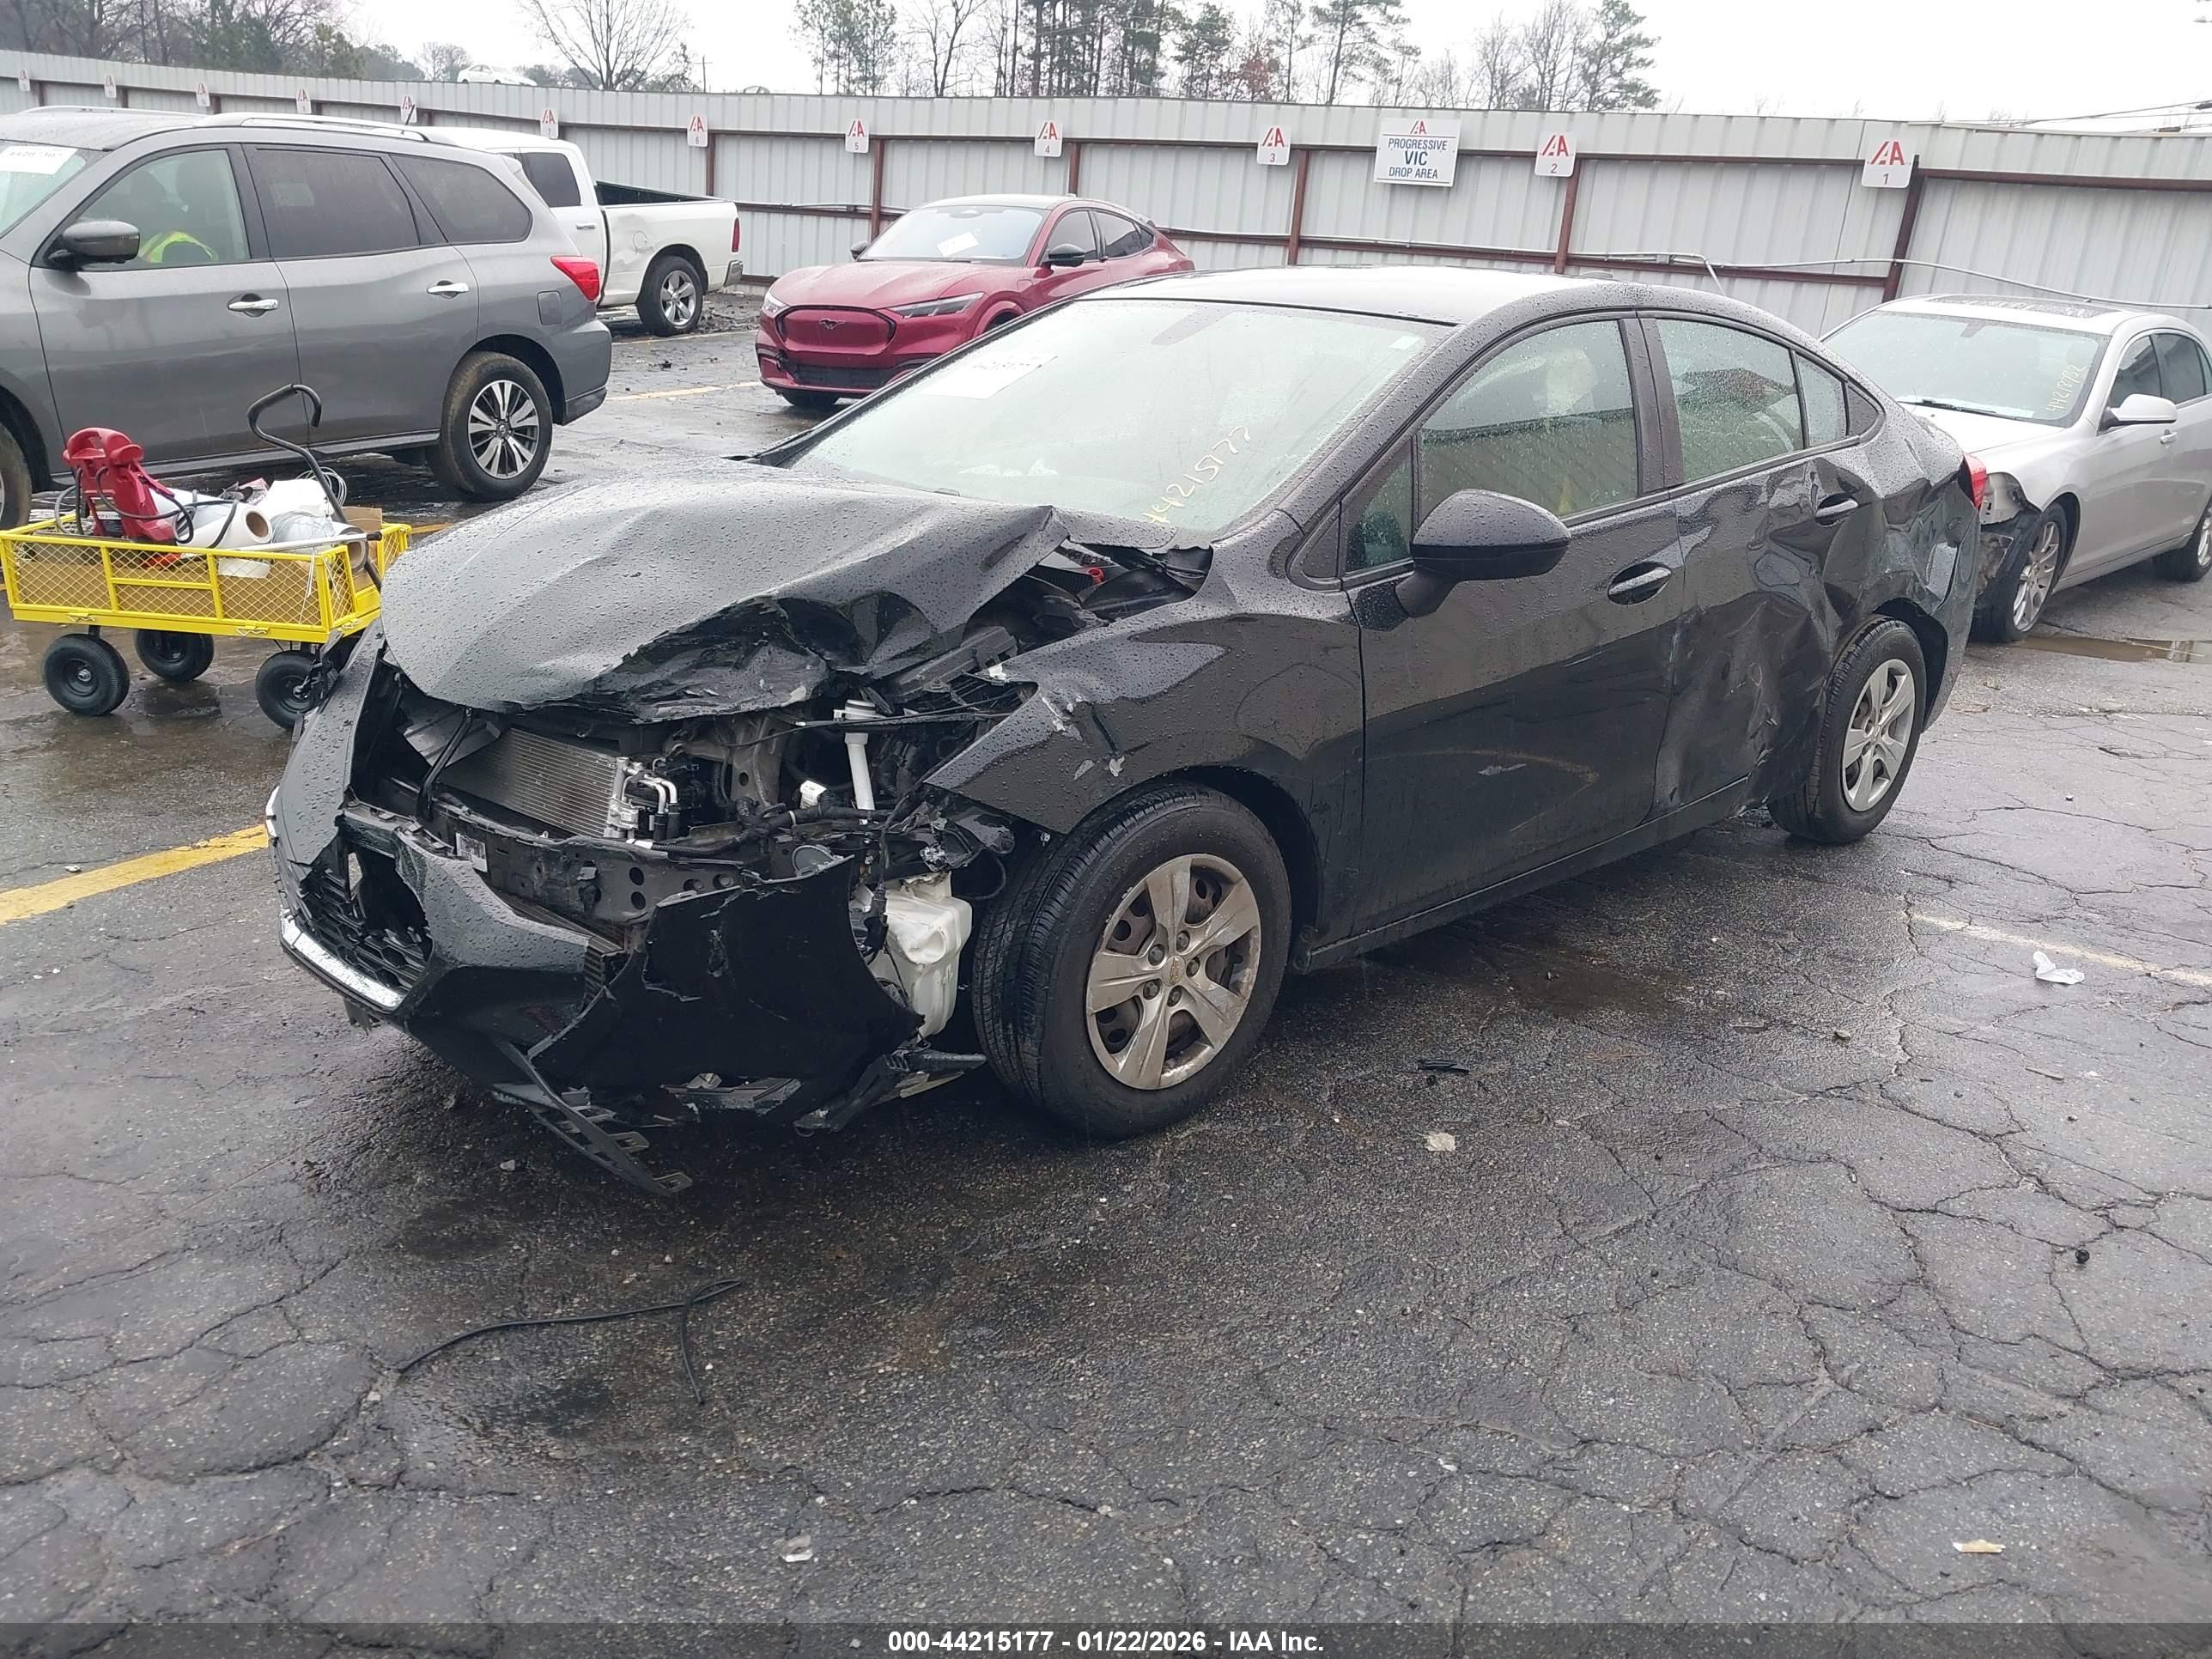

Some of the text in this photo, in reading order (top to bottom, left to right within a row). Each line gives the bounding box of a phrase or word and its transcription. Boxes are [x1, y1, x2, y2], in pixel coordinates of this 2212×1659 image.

[854, 142, 860, 150] 5
[1045, 144, 1050, 154] 4
[1388, 138, 1448, 150] PROGRESSIVE
[1270, 152, 1276, 162] 3
[1405, 150, 1428, 166] VIC
[1389, 166, 1438, 179] DROP AREA
[1551, 163, 1558, 173] 2
[1883, 173, 1889, 185] 1
